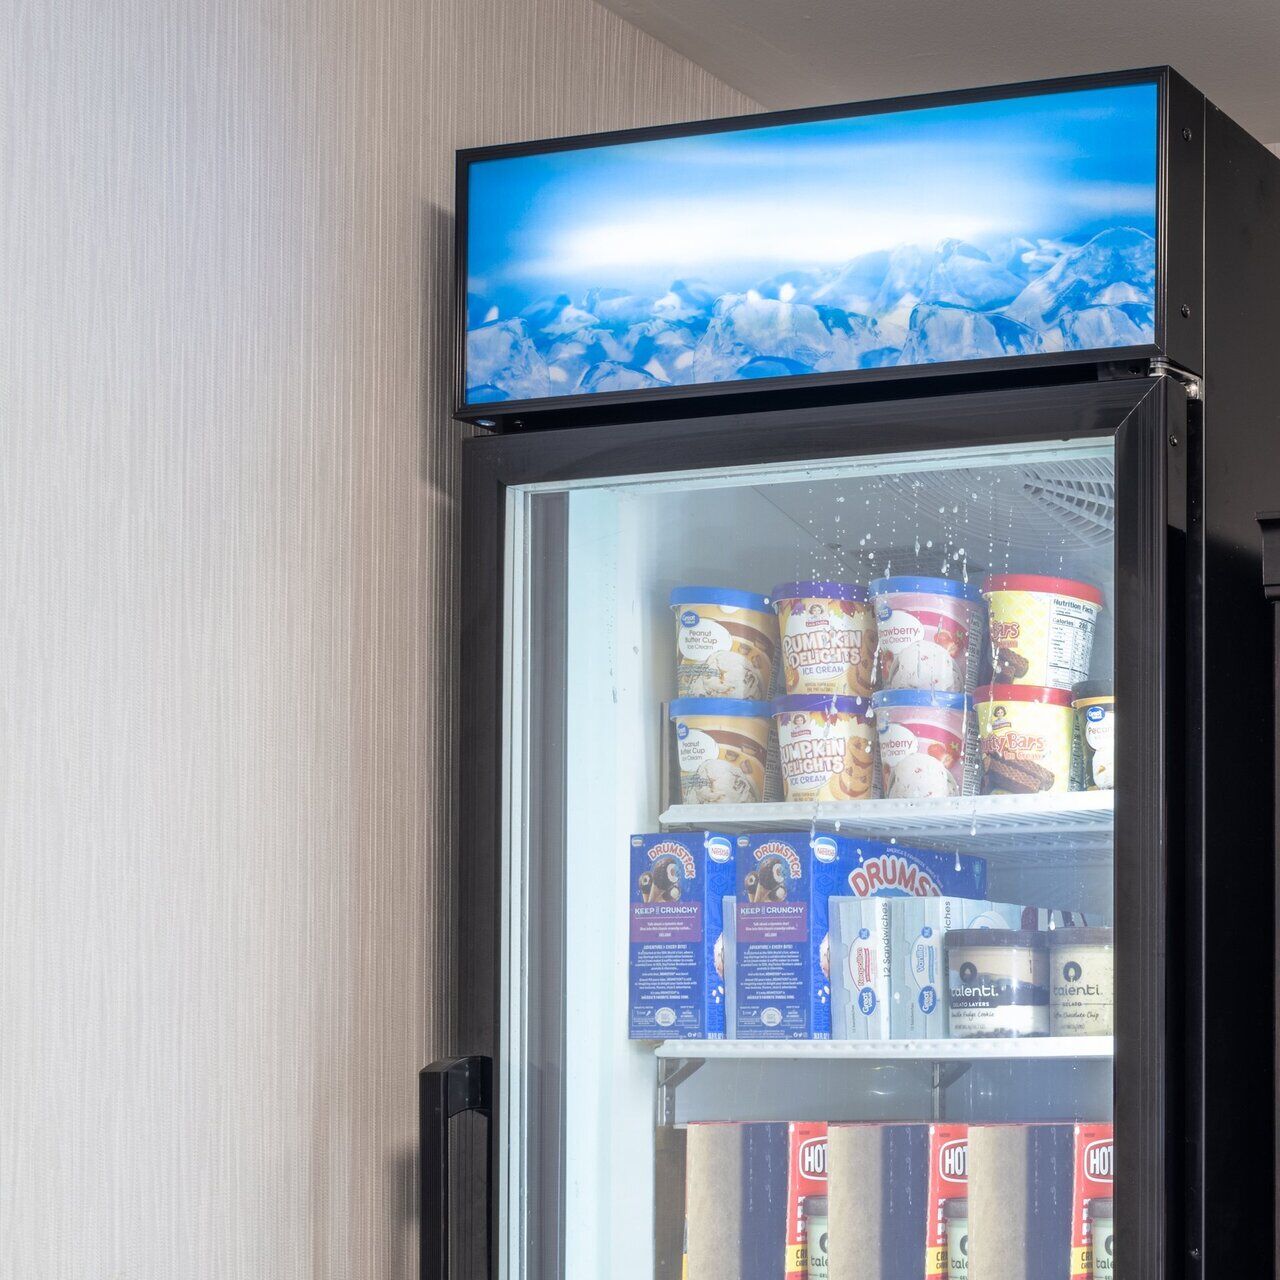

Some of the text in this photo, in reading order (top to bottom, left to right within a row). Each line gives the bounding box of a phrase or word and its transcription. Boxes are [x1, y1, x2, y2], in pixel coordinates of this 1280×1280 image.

[689, 629, 712, 637] Peanut
[784, 630, 862, 655] PUMPKIN
[789, 649, 861, 669] DELIGHTS
[802, 666, 844, 675] ICE CREAM
[648, 842, 696, 879] DRUMSTICK
[754, 842, 802, 879] DRUMSTICK
[882, 902, 891, 961] Sandwiches
